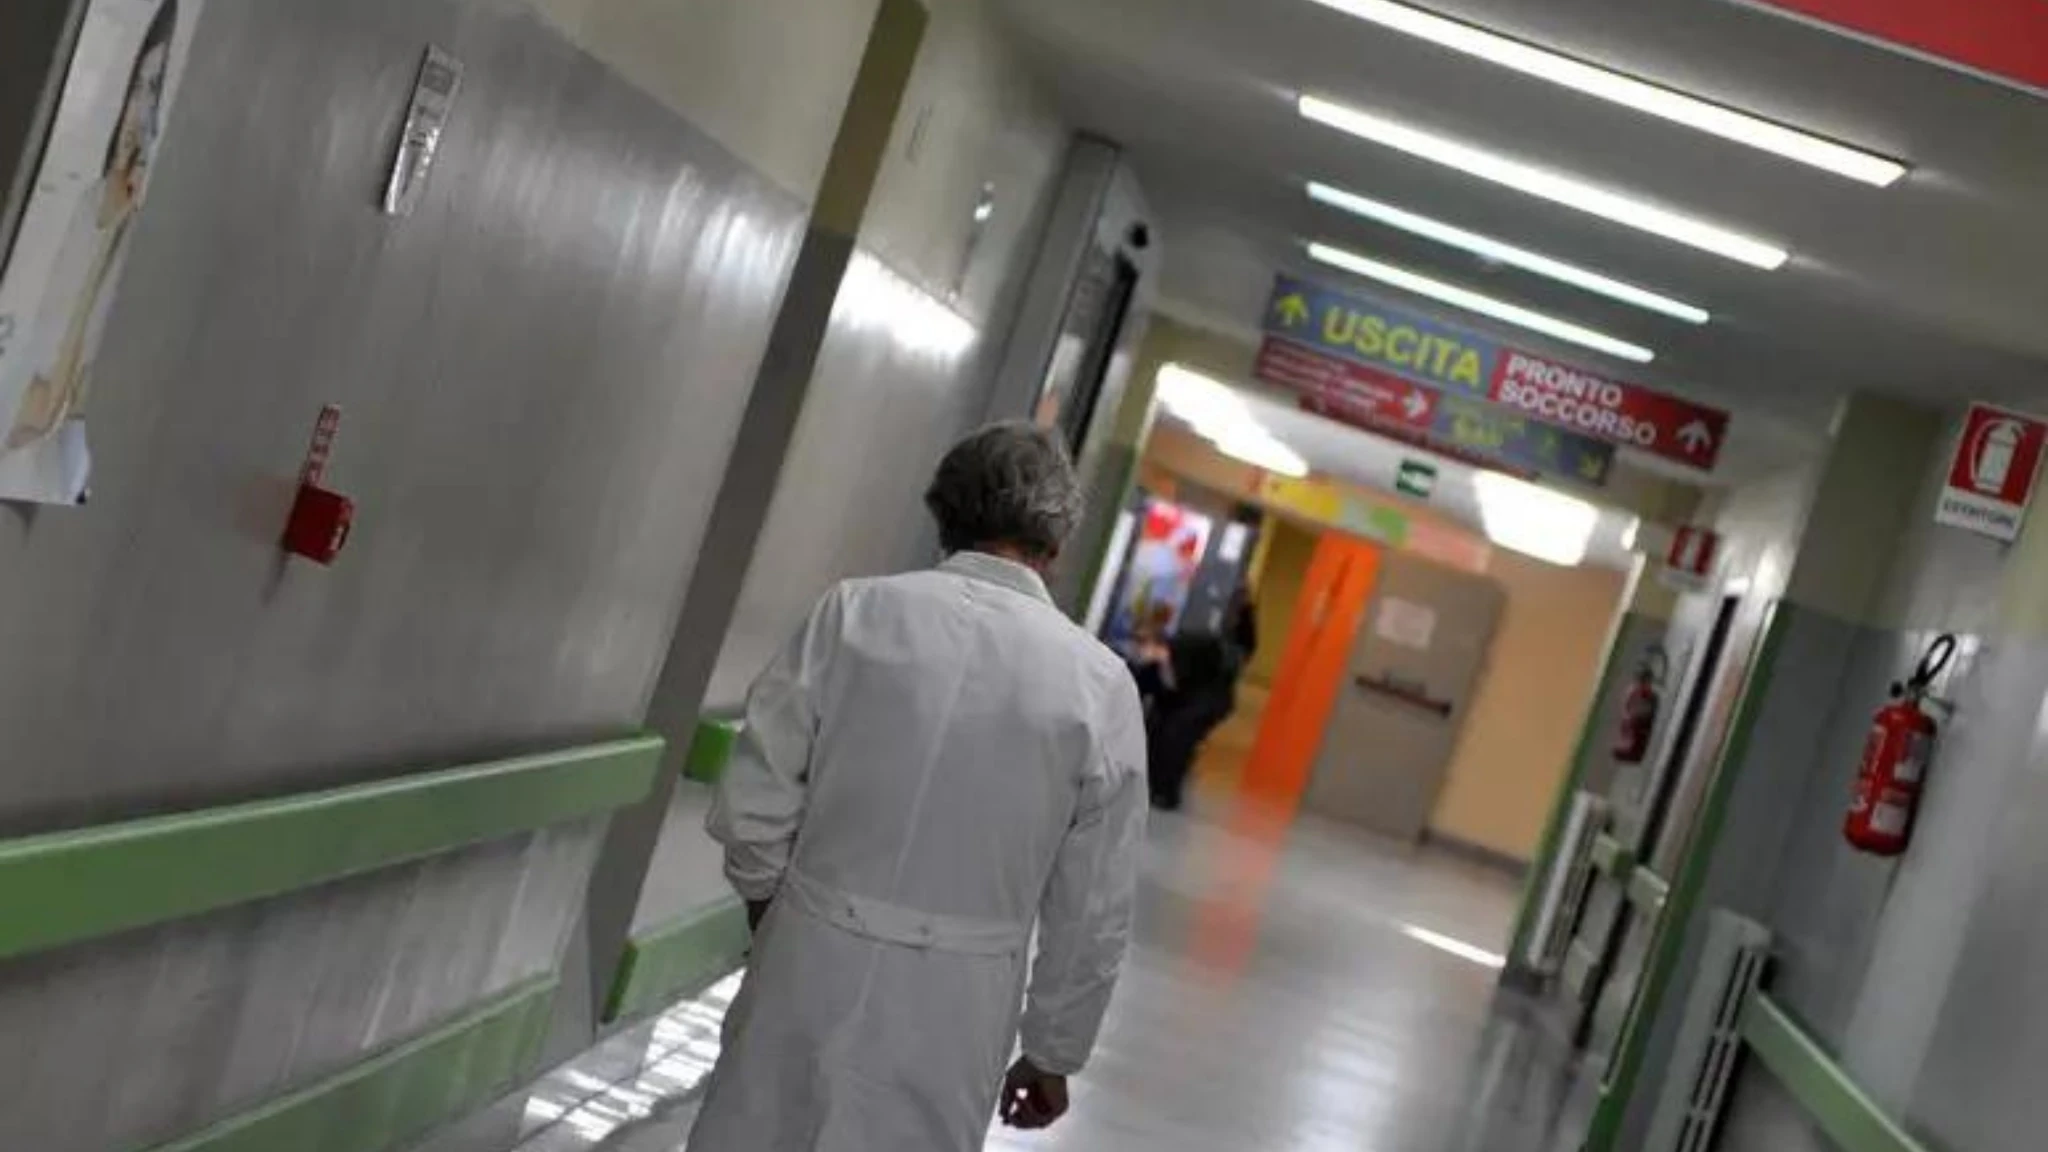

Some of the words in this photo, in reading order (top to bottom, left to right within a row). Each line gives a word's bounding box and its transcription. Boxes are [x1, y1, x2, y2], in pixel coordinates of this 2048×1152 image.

[1323, 306, 1482, 386] USCITA
[1506, 352, 1624, 409] PRONTO
[1499, 377, 1657, 446] SOCCORSO
